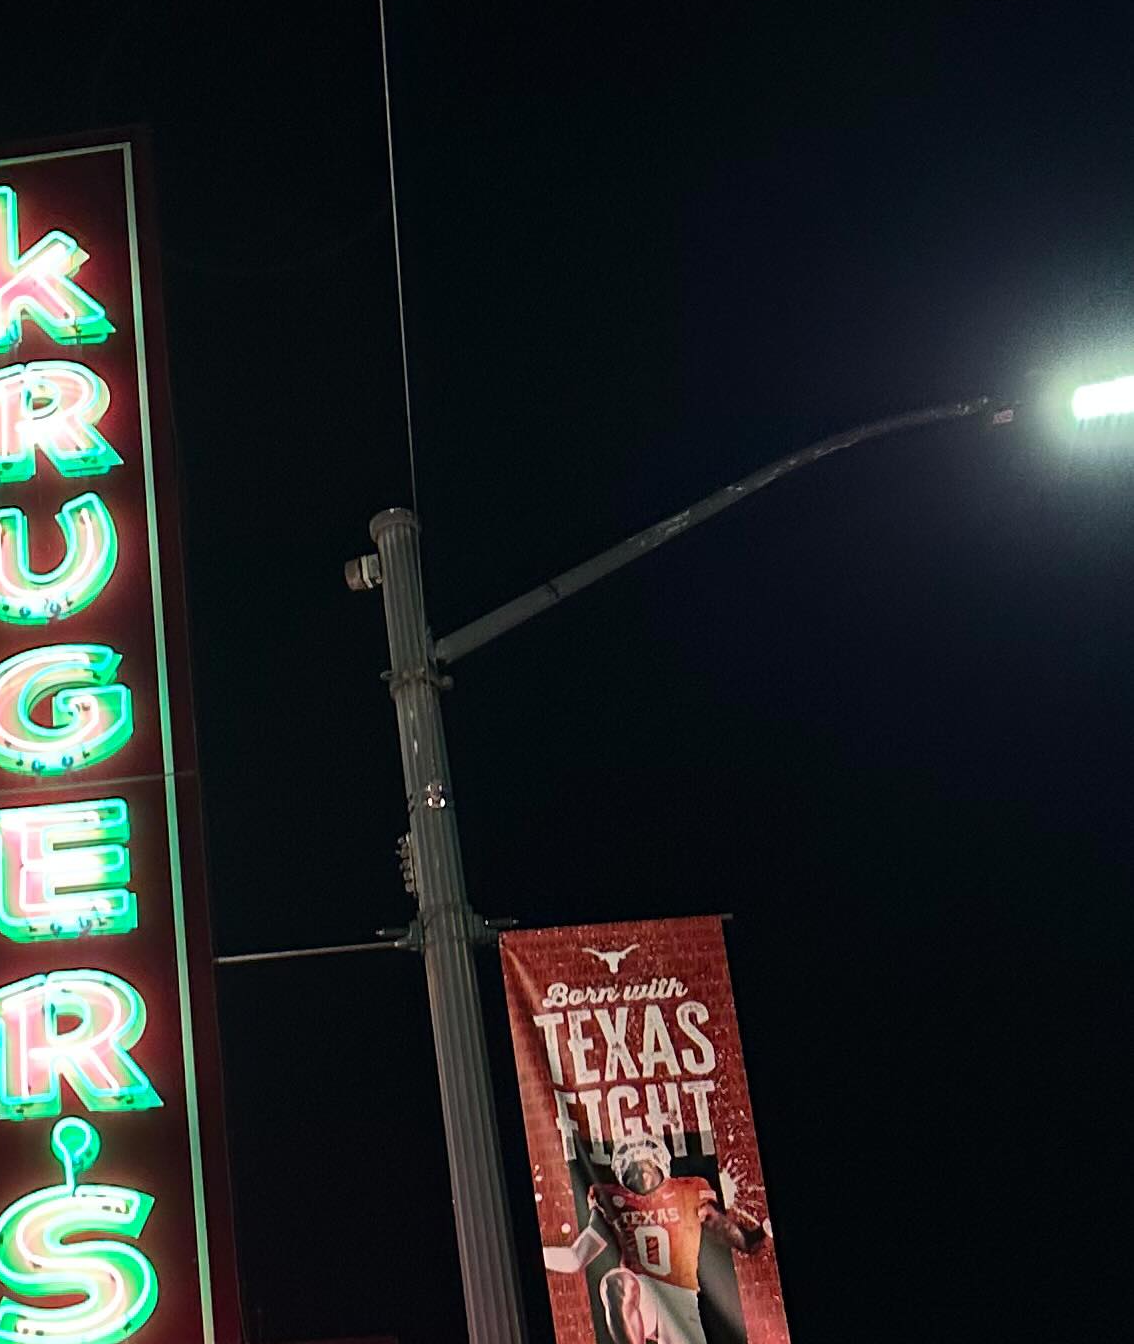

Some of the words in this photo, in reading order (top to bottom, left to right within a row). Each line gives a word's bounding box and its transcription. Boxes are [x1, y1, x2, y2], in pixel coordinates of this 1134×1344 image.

[542, 982, 620, 1008] Born
[623, 977, 688, 1001] with
[533, 1001, 716, 1086] TEXAS
[554, 1080, 715, 1165] FIGHT
[620, 1207, 680, 1226] TEXAS
[634, 1225, 672, 1276] 0
